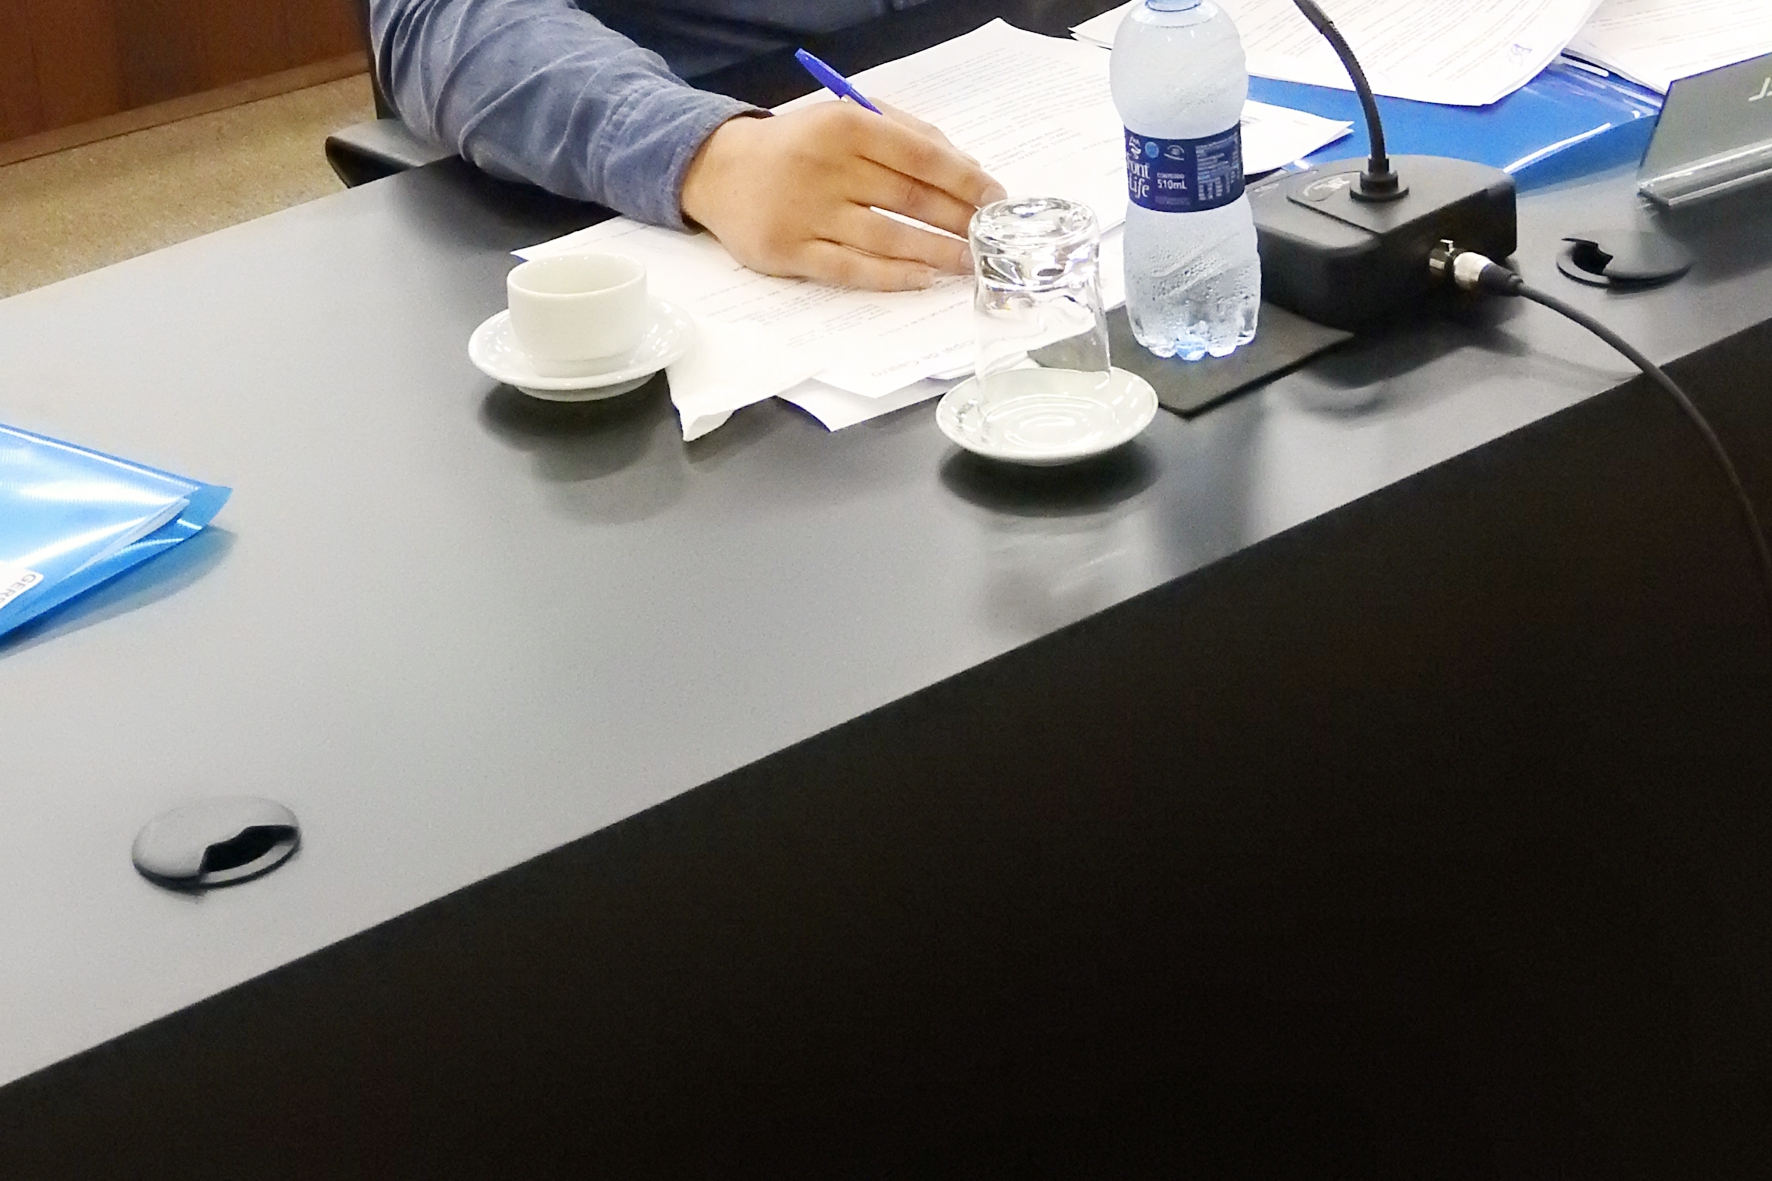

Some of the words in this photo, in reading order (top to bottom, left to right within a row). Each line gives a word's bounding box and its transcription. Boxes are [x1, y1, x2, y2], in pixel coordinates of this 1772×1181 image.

[1748, 77, 1772, 101] J
[1129, 172, 1150, 199] Life
[1157, 179, 1187, 190] 510mL
